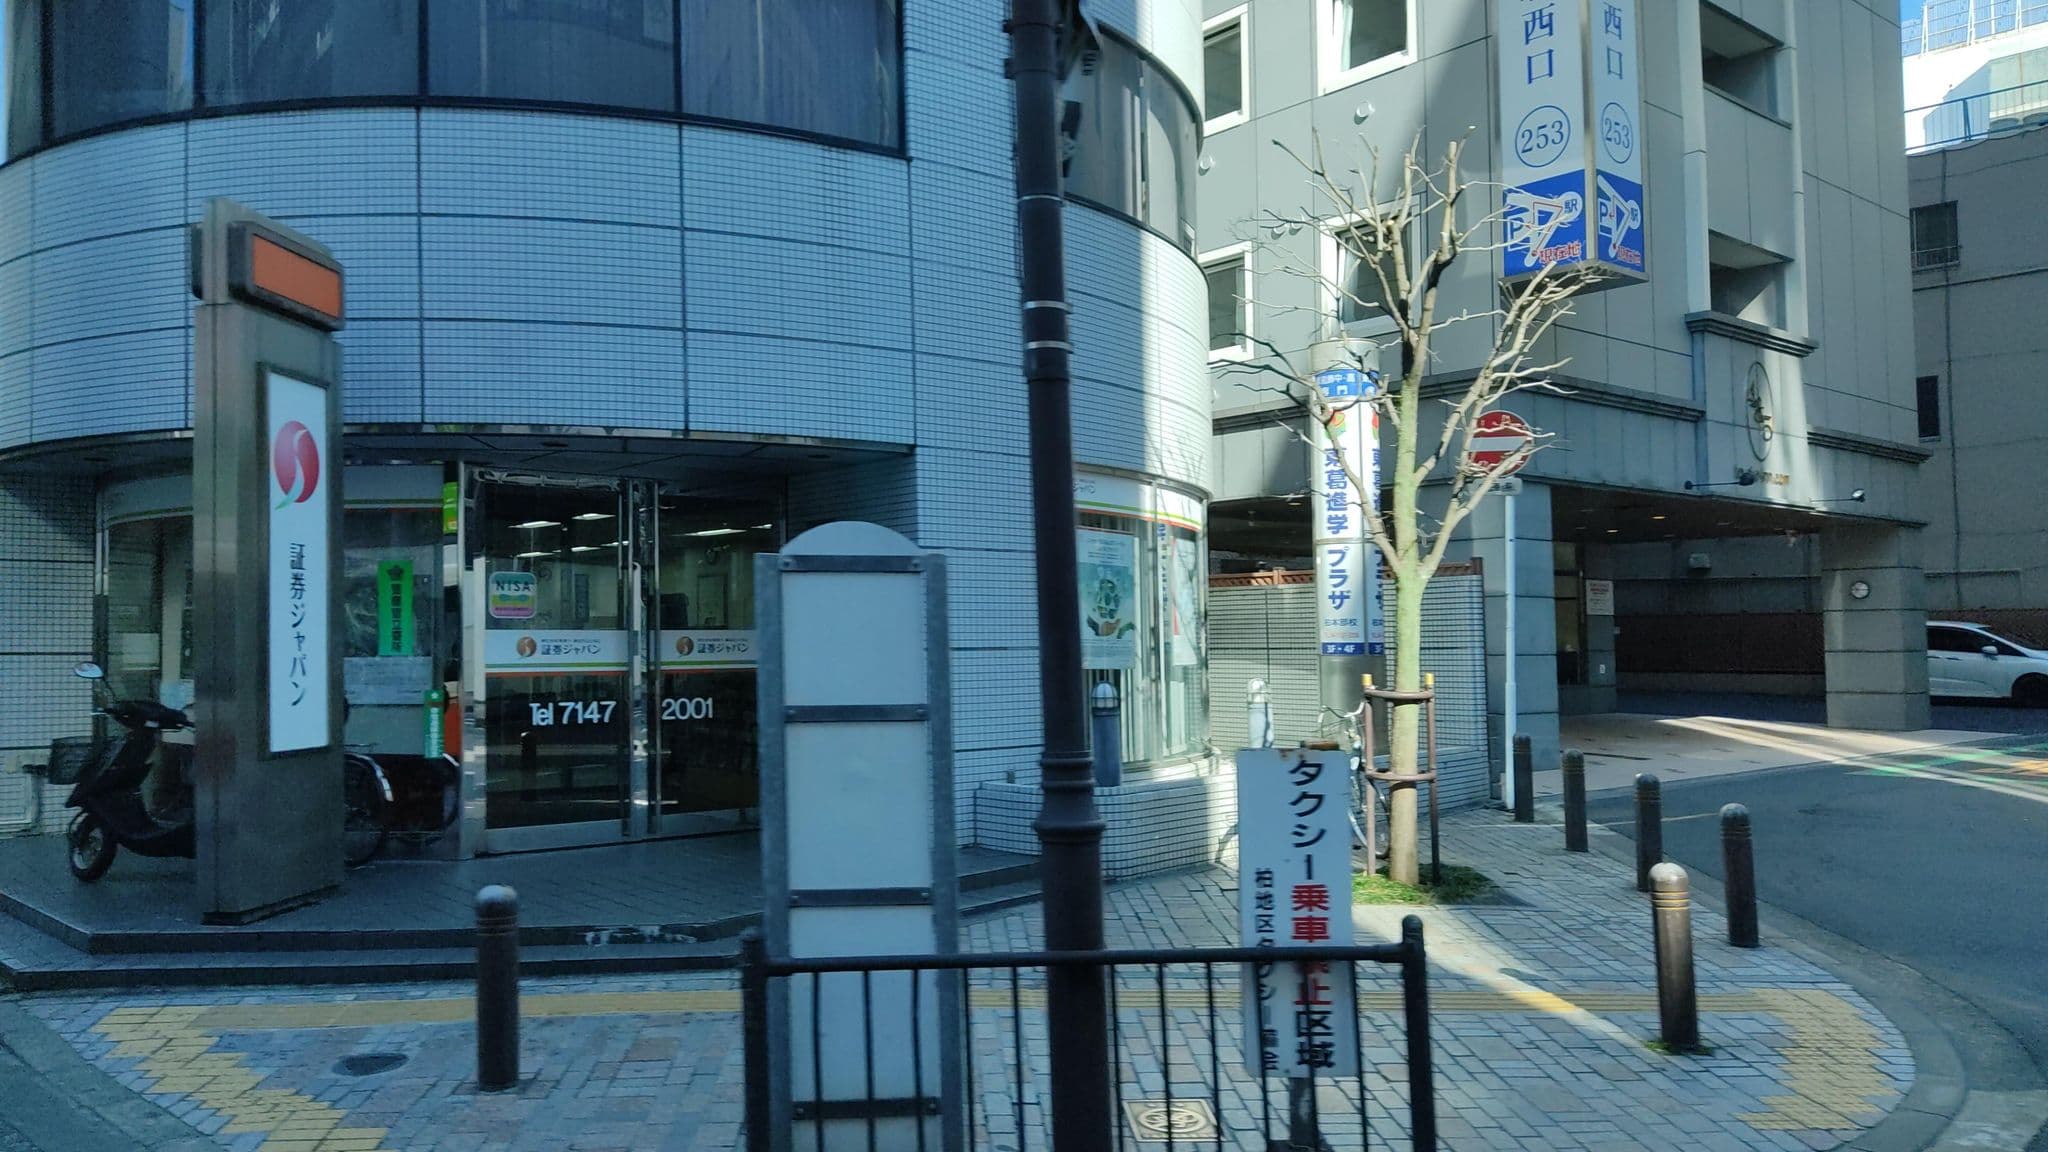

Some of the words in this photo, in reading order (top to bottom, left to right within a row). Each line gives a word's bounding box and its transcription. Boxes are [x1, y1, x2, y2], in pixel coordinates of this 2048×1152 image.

[1521, 1, 1555, 84] 西口
[1521, 120, 1564, 154] 253
[1604, 117, 1630, 149] 253
[495, 580, 533, 593] NISA
[290, 542, 307, 706] 証券ジャパン
[541, 643, 601, 656] 証券ジャパン
[697, 643, 749, 654] 証券ジャパン
[529, 702, 554, 726] Tel
[560, 701, 617, 725] 7147
[661, 697, 713, 720] 2001
[1288, 759, 1336, 1069] タクシー乗車止区域
